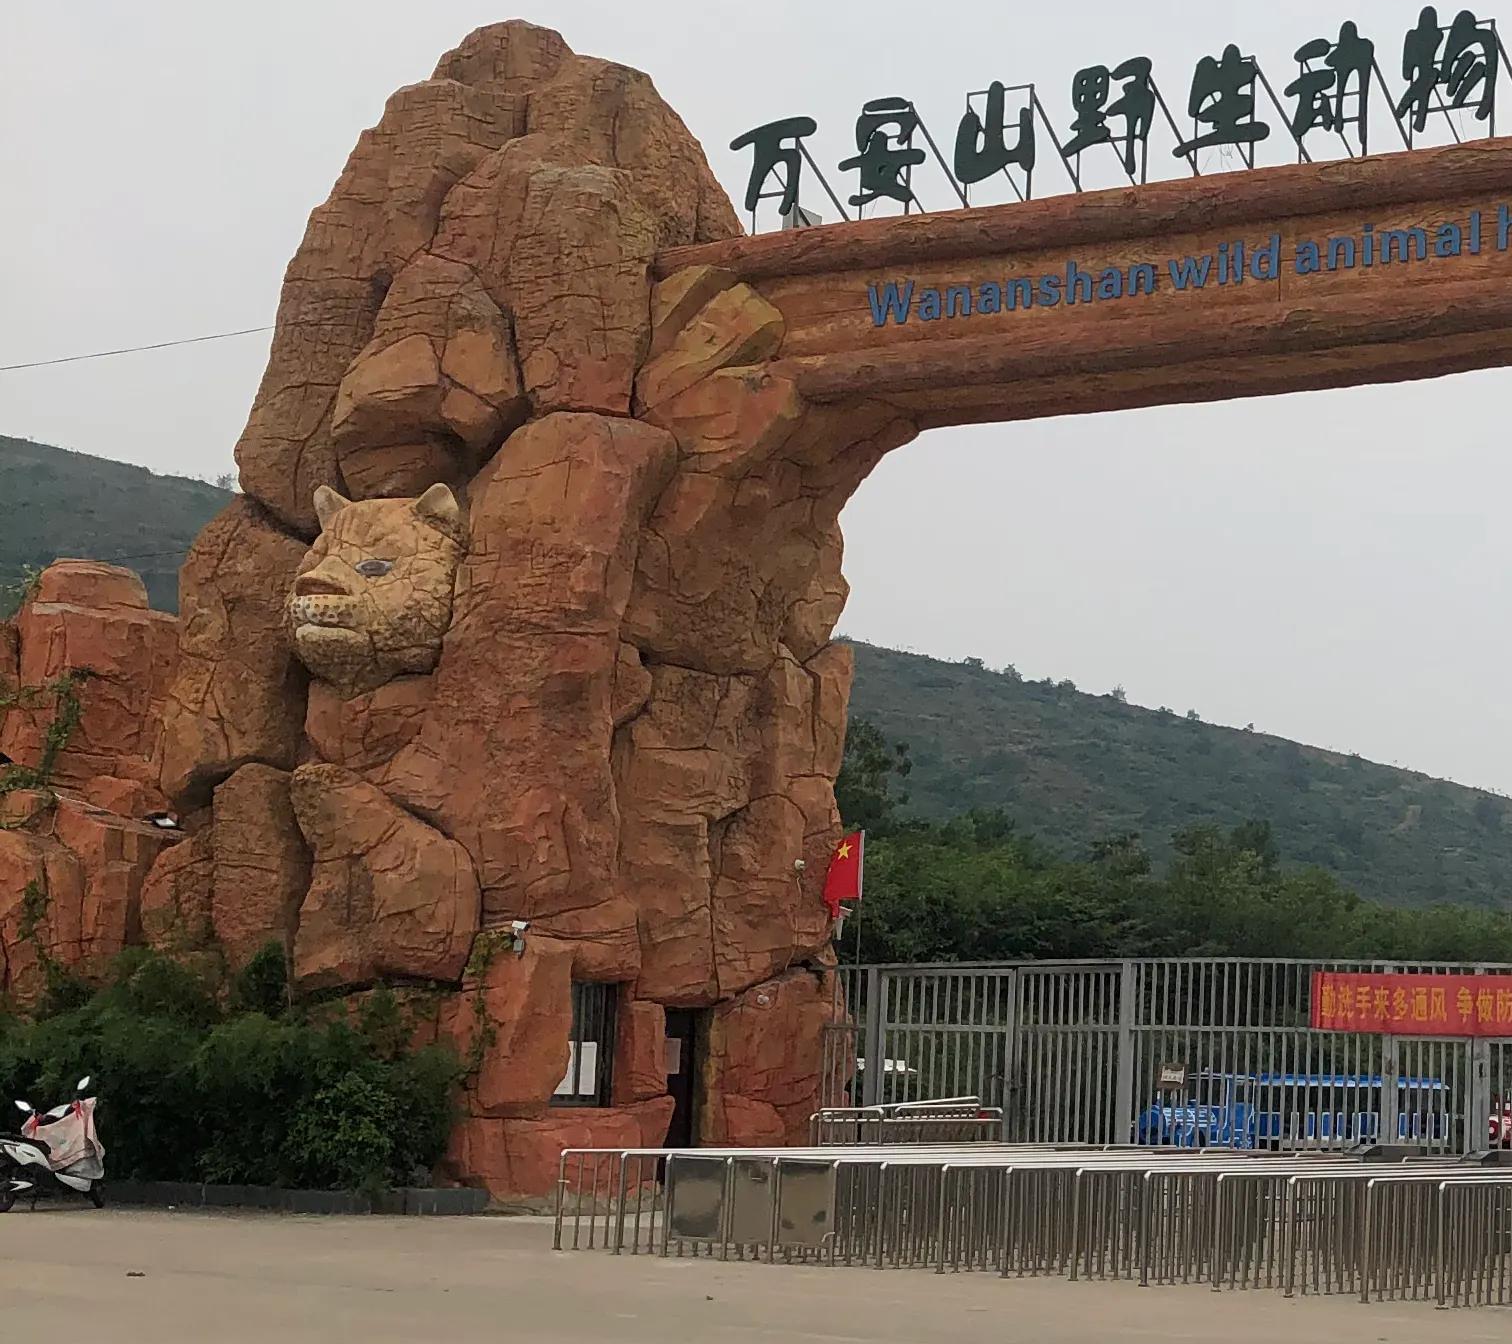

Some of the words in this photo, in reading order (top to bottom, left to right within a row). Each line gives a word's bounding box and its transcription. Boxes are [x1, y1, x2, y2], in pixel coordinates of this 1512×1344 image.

[868, 260, 1155, 326] Wananshan
[1168, 234, 1281, 290] wild
[1295, 212, 1480, 273] animal
